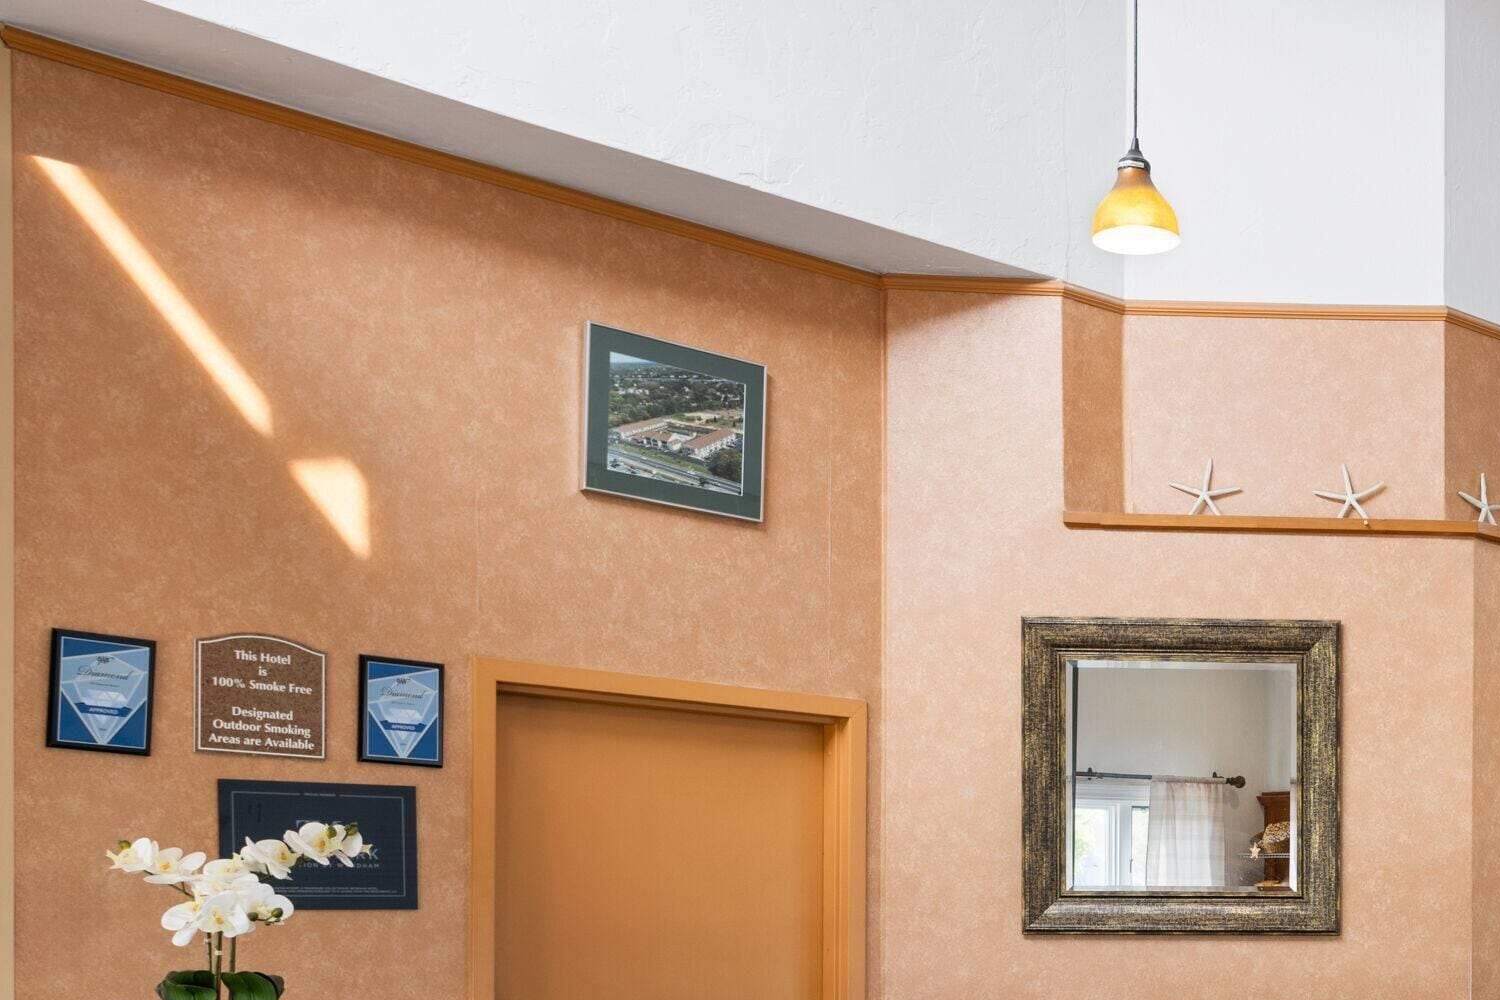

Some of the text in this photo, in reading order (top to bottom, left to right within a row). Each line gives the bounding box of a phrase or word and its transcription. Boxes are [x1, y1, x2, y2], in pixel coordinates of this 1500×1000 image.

[234, 649, 291, 665] This Hotel
[77, 665, 135, 681] Diamond
[258, 666, 268, 676] is
[212, 676, 313, 695] 100% Smoke Free
[379, 686, 427, 699] Diamond
[232, 706, 294, 721] Designated
[212, 719, 311, 739] Outdoor Smoking
[208, 733, 315, 750] Areas are Available
